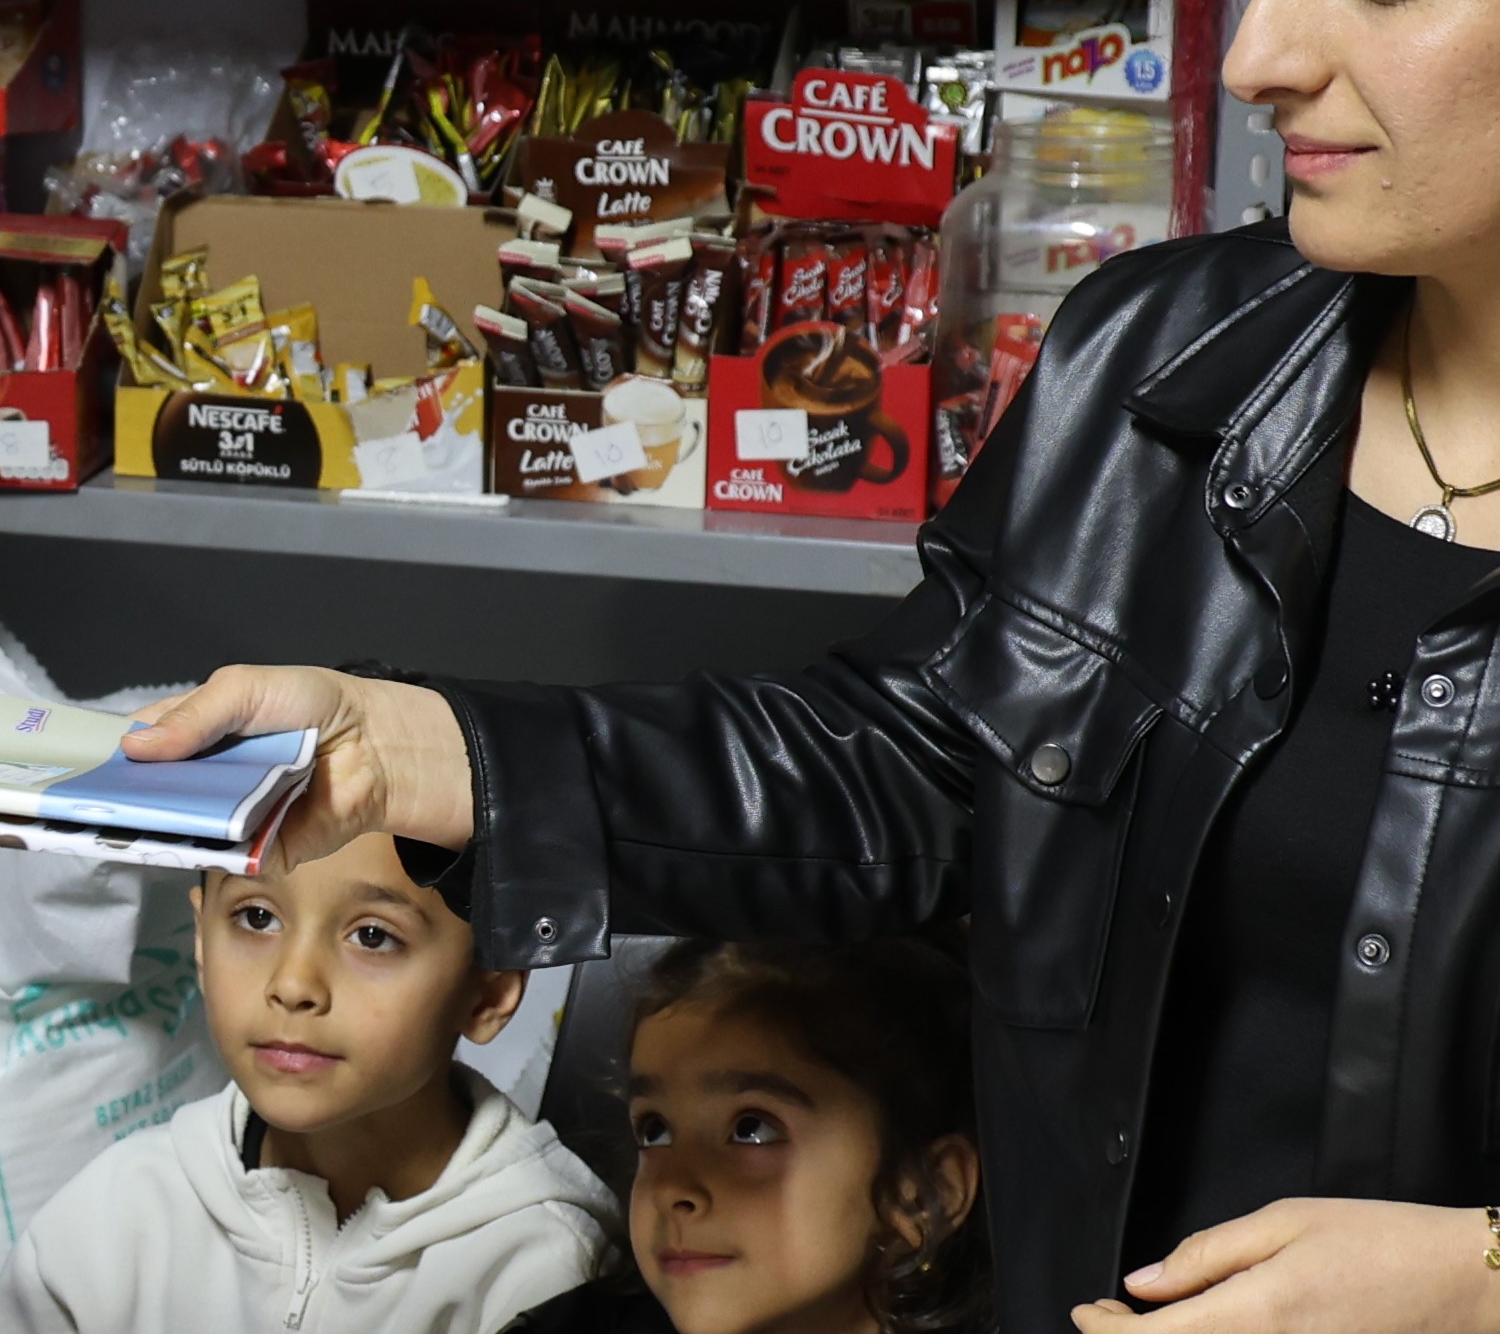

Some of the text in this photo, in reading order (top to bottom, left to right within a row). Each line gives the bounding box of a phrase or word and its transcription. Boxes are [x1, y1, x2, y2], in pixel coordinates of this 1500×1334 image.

[803, 78, 890, 115] CAFÉ
[596, 138, 645, 155] CAFÉ
[761, 107, 937, 171] CROWN
[575, 157, 670, 185] CROWN
[597, 192, 652, 217] Latte
[188, 403, 285, 434] NESCAFÉ
[526, 403, 567, 419] CAFÉ
[506, 418, 590, 445] CROWN
[180, 458, 291, 479] SÜTLÜ KÖPÜKLÜ
[519, 449, 575, 475] Latte
[729, 467, 764, 481] CAFÉ
[714, 480, 784, 503] CROWN
[95, 1083, 153, 1128] BEYAZ
